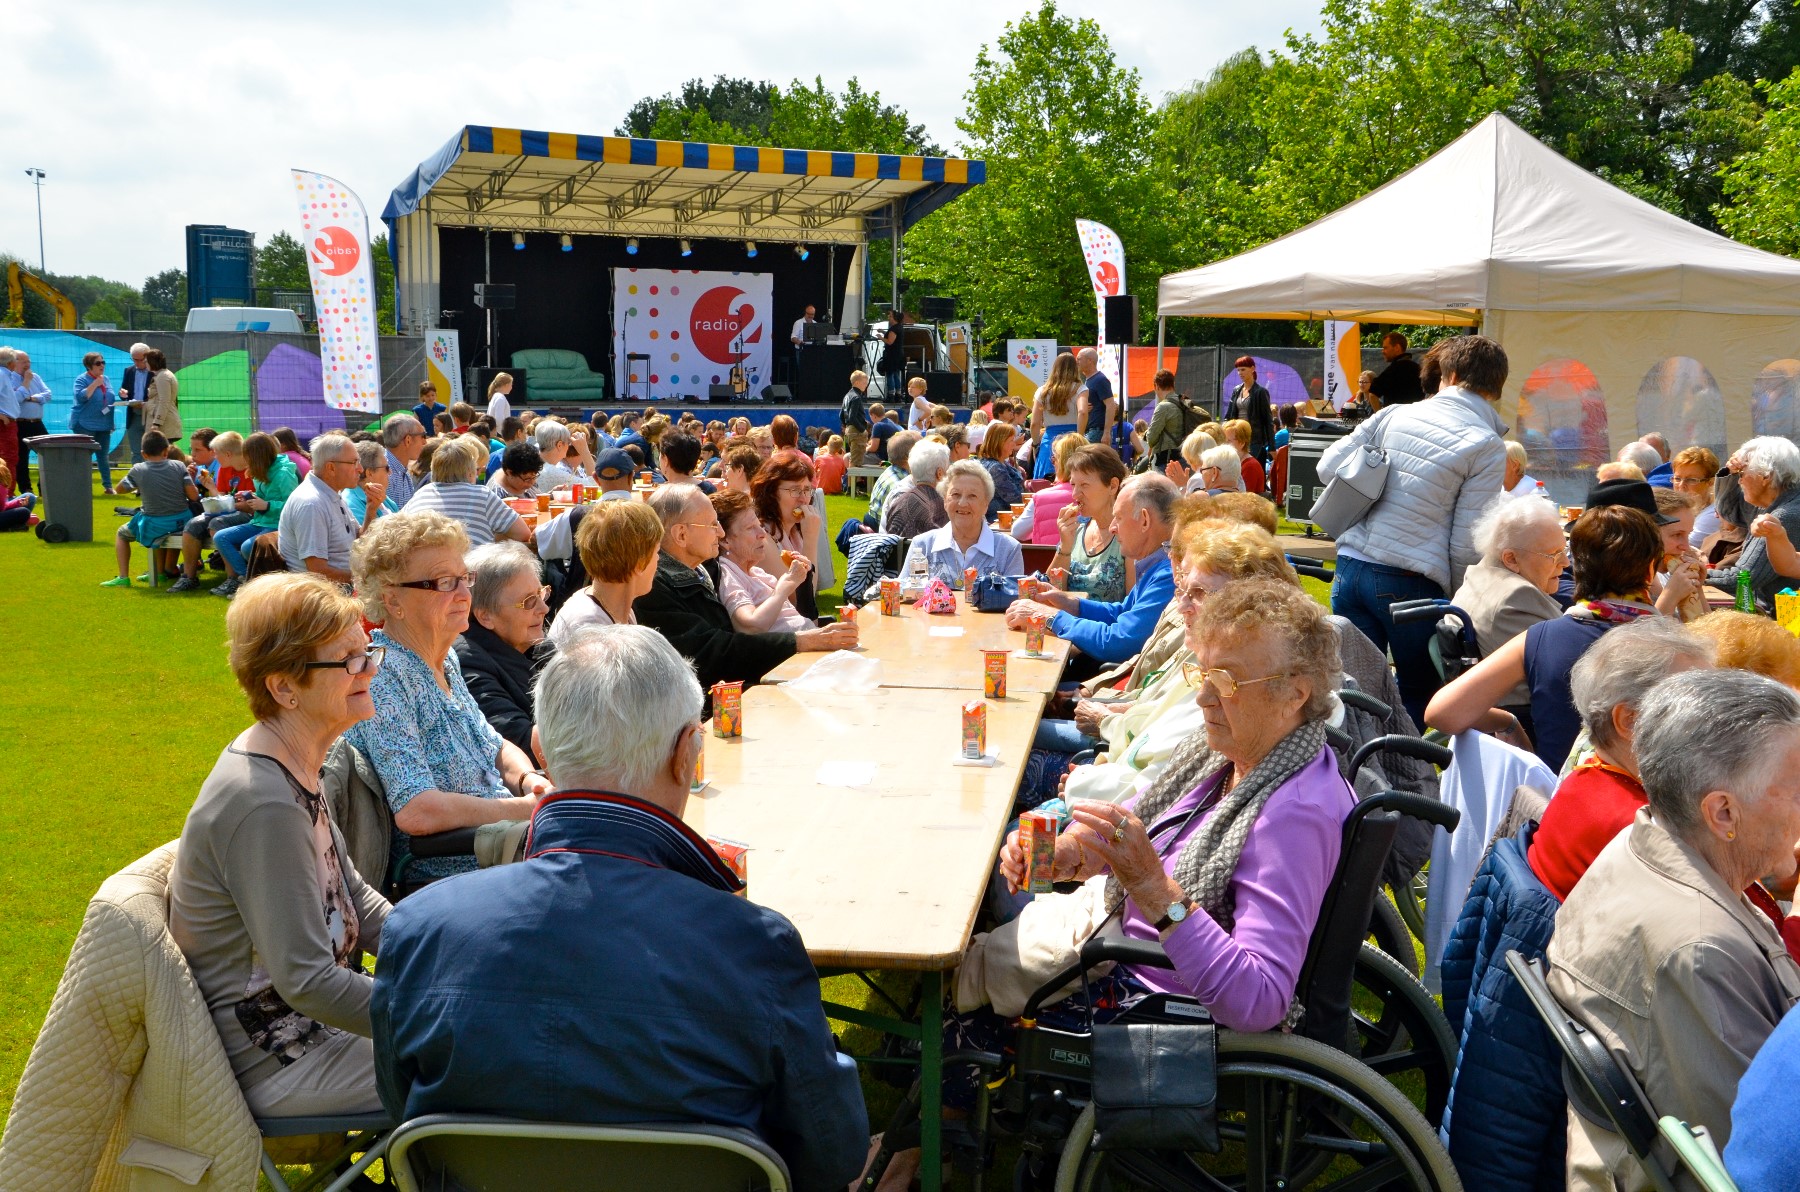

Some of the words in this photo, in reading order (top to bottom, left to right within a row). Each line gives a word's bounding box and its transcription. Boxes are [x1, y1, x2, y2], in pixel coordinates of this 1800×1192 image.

[695, 318, 738, 331] radio
[728, 292, 762, 354] 2
[1041, 344, 1049, 367] actief
